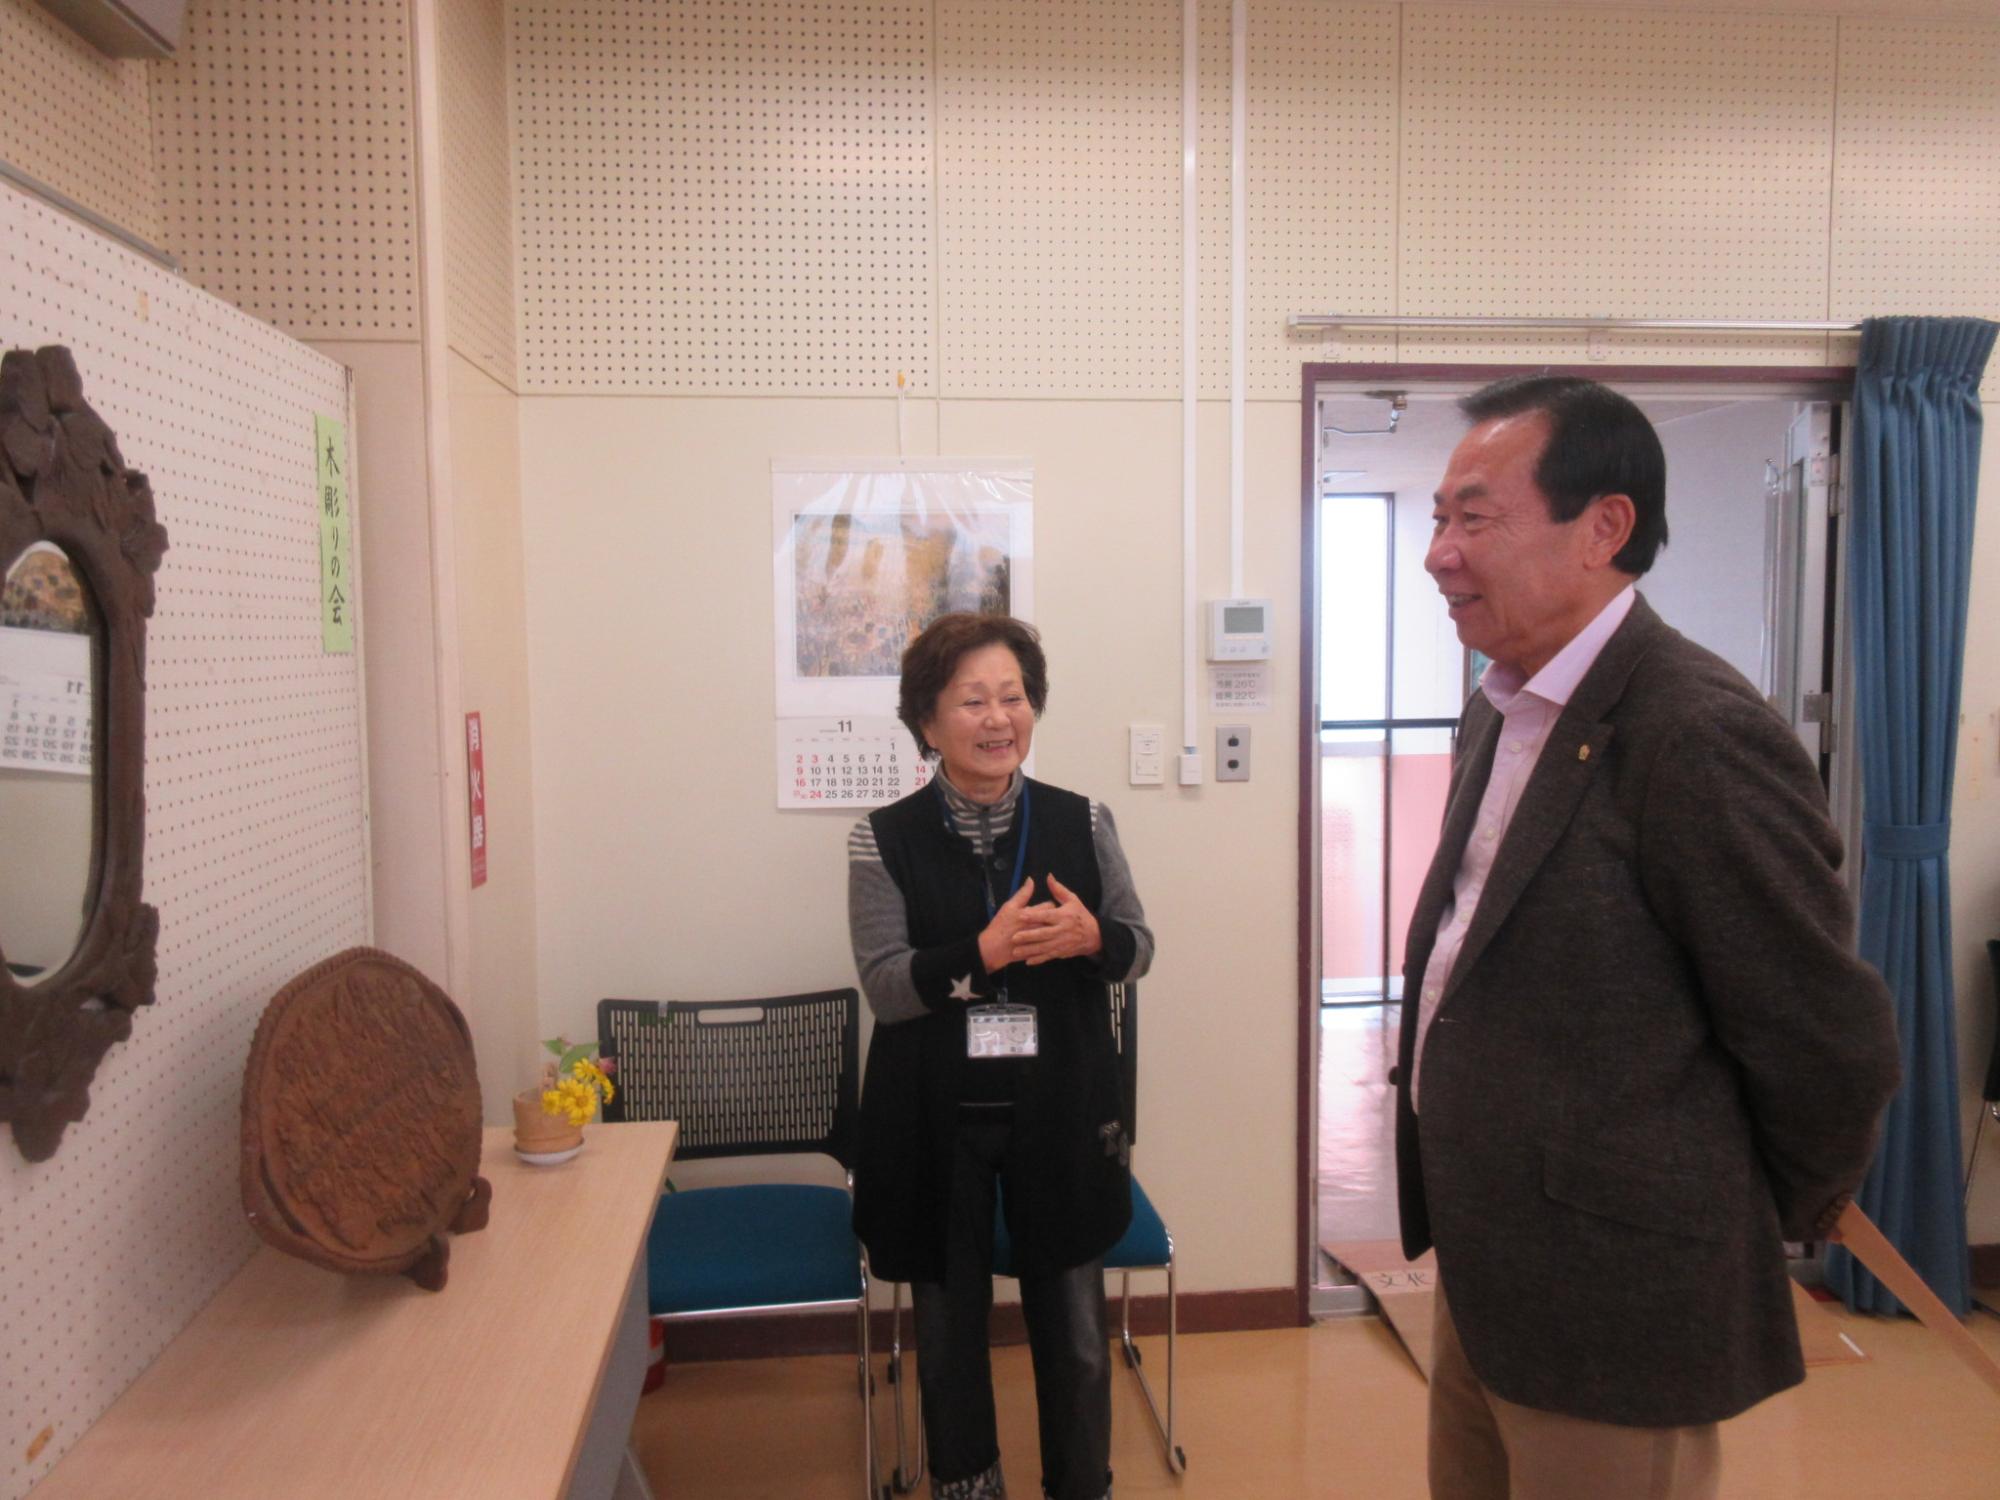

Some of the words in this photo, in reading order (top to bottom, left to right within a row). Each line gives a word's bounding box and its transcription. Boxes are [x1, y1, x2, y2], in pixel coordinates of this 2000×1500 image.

[325, 436, 344, 625] 木彫りの会
[838, 720, 852, 733] 11
[890, 743, 895, 751] 1
[796, 755, 803, 763] 2
[812, 755, 818, 763] 3
[828, 755, 834, 763] 4
[843, 755, 850, 763] 5
[859, 755, 865, 763] 6
[875, 755, 881, 763] 7
[890, 755, 896, 763] 8
[797, 767, 803, 775] 9
[811, 767, 822, 775] 10
[827, 767, 836, 775] 11
[842, 767, 851, 775] 12
[858, 767, 868, 775] 13
[873, 767, 883, 775] 14
[889, 767, 899, 775] 15
[915, 766, 926, 774] 14
[796, 778, 806, 787] 16
[811, 778, 821, 787] 17
[827, 778, 837, 787] 18
[843, 778, 852, 787] 19
[856, 778, 868, 787] 20
[872, 778, 883, 787] 21
[888, 778, 900, 787] 22
[915, 778, 927, 786] 21
[809, 790, 822, 799] 24
[825, 790, 838, 799] 25
[841, 790, 854, 799] 26
[857, 790, 869, 799] 27
[872, 790, 885, 799] 28
[888, 790, 900, 799] 29
